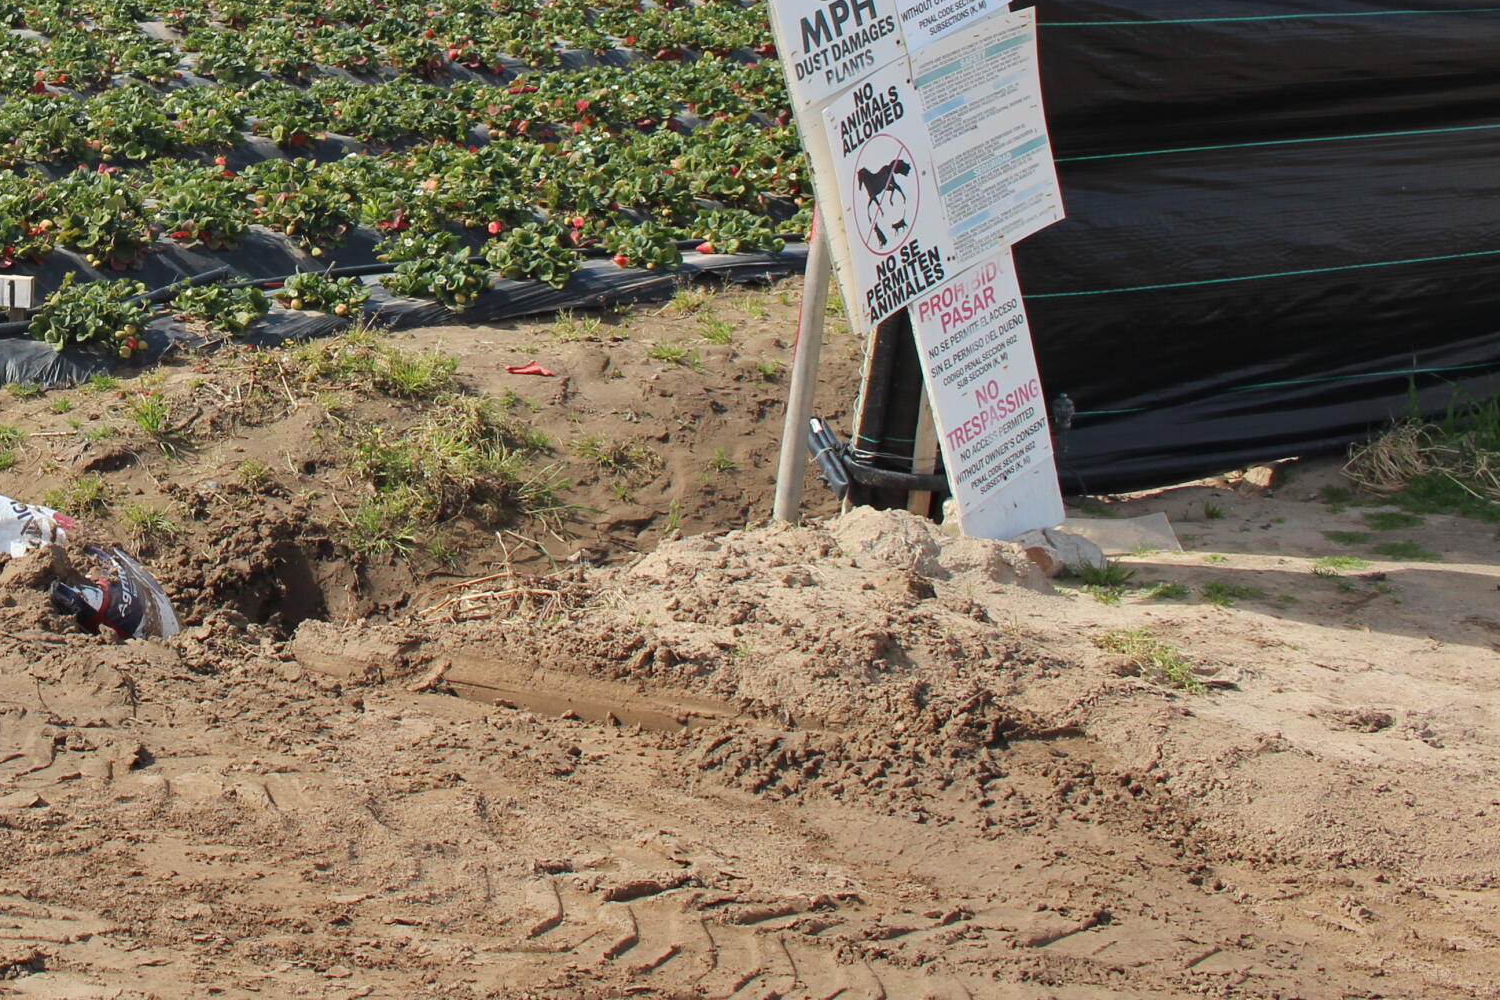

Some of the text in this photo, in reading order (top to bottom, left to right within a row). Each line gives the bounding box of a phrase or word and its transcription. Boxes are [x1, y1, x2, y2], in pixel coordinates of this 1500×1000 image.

[918, 14, 938, 30] PENAL
[938, 4, 954, 19] CODE
[929, 8, 970, 36] SUBSECTIONS
[795, 48, 830, 81] DUST
[831, 15, 895, 63] DAMAGES
[825, 48, 874, 86] PLANTS
[841, 85, 898, 140] ANIMALS
[853, 82, 873, 108] NO
[842, 101, 904, 158] ALLOWED
[866, 246, 940, 308] PERMITEN
[876, 238, 920, 281] NO SE
[870, 262, 944, 324] ANIMALES
[940, 286, 996, 334] PASAR
[928, 346, 940, 360] NO
[940, 339, 950, 352] SE
[980, 316, 989, 328] EL
[989, 298, 1018, 321] ACCESO
[931, 364, 944, 378] SIN
[944, 358, 953, 372] EL
[953, 338, 984, 364] PERMISO
[985, 330, 998, 346] DEL
[943, 368, 964, 386] CODIGO
[956, 376, 969, 390] SUB
[969, 362, 993, 382] SECCION
[946, 378, 1039, 452] TRESPASSING
[974, 380, 999, 408] NO
[955, 416, 1046, 486] WITHOUT OWNER'S CONSENT
[960, 406, 1035, 462] NO ACCESS PERMITTED
[970, 474, 988, 490] PENAL
[988, 463, 1002, 478] CODE
[1002, 448, 1024, 467] SECTION
